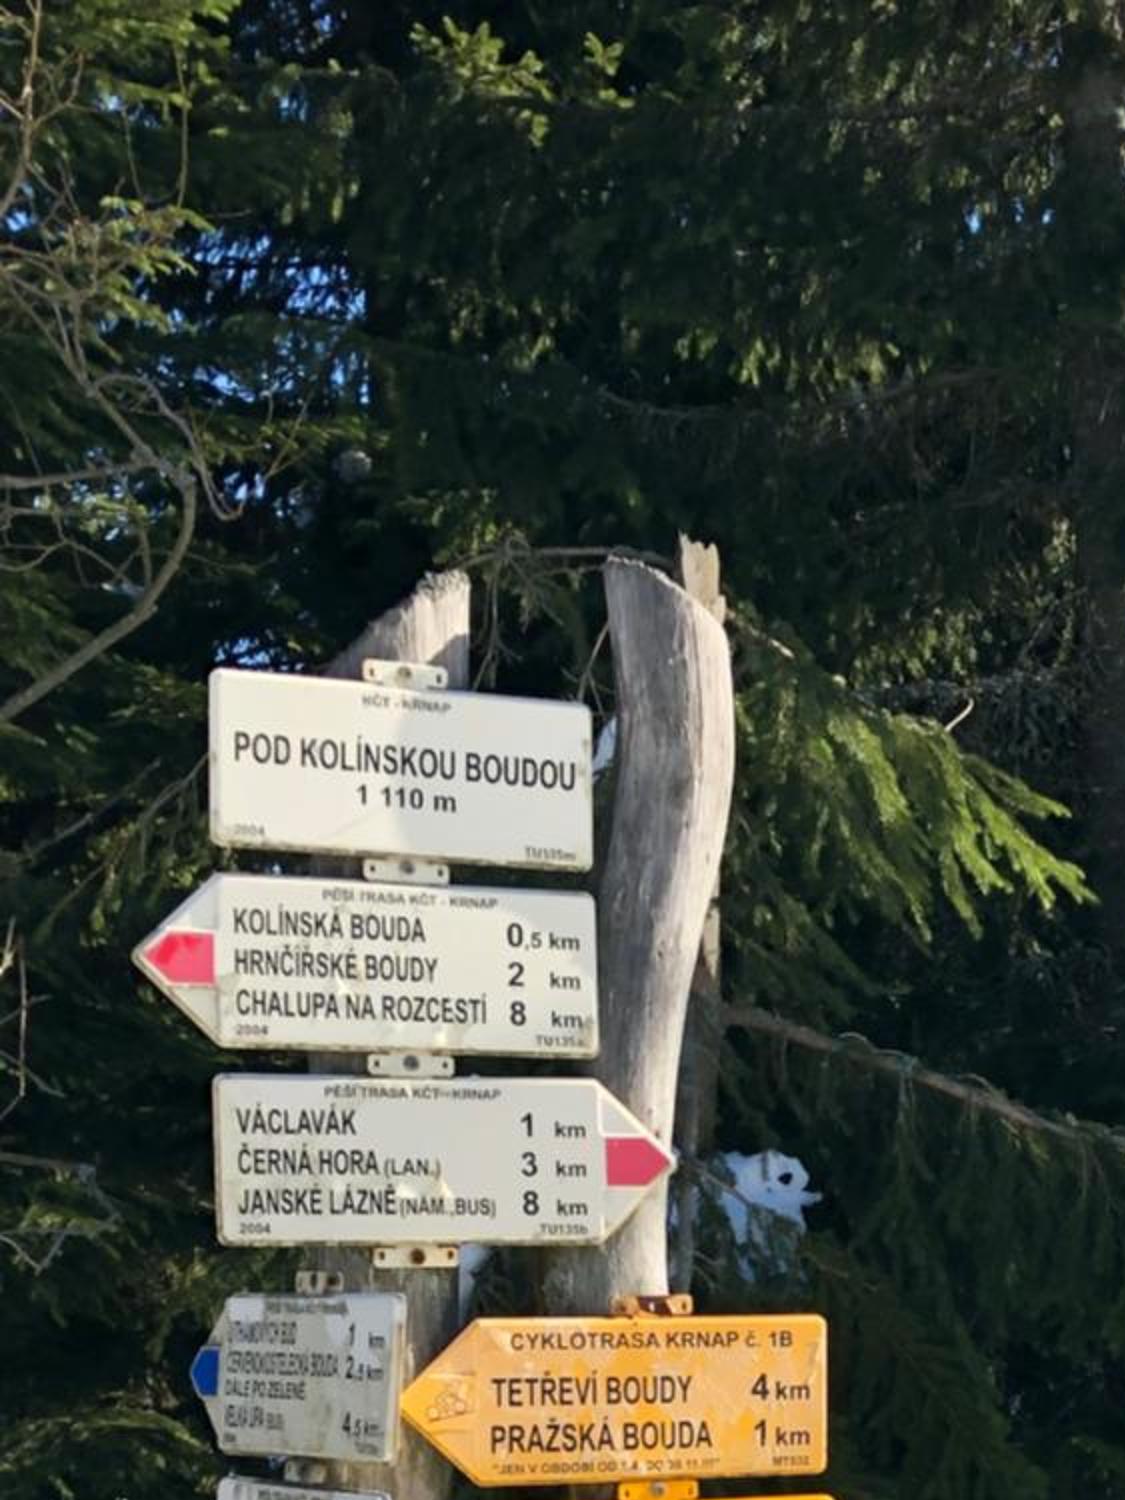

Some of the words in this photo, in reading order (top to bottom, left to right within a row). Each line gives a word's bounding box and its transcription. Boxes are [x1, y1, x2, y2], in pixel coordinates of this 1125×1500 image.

[234, 731, 290, 764] POD
[301, 735, 455, 780] KOLÍNSKOU
[465, 752, 575, 790] BOUDOU
[357, 785, 368, 806] 1
[383, 787, 424, 809] 110
[433, 794, 456, 812] m
[361, 890, 406, 905] TRASA
[450, 897, 498, 909] KRNAP
[233, 905, 344, 938] KOLÍNSKÁ
[351, 914, 426, 943] BOUDA
[507, 923, 542, 950] 0,5
[549, 932, 580, 951] km
[234, 944, 357, 979] HRNČÍŘSKÉ
[365, 955, 438, 982] BOUDY
[508, 962, 524, 987] 2
[550, 971, 581, 990] km
[237, 989, 336, 1018] CHALUPA
[346, 994, 375, 1020] NA
[382, 992, 487, 1025] ROZCESTÍ
[510, 1001, 526, 1027] 8
[551, 1010, 583, 1029] km
[236, 1023, 268, 1036] 2004
[362, 1086, 408, 1099] TRASA
[452, 1088, 501, 1100] KRNAP
[237, 1106, 356, 1135] VÁCLAVÁK
[520, 1114, 534, 1138] 1
[554, 1121, 586, 1139] km
[238, 1143, 313, 1175] ČERNÁ
[319, 1149, 379, 1175] HORA
[384, 1158, 441, 1179] (LAN.)
[521, 1152, 538, 1177] 3
[555, 1161, 587, 1179] km
[238, 1183, 322, 1216] JANSKÉ
[329, 1183, 396, 1215] LÁZNĚ
[523, 1190, 539, 1216] 8
[557, 1199, 588, 1216] km
[239, 1222, 271, 1235] 2004
[368, 1332, 386, 1349] km
[511, 1330, 660, 1351] CYKLOTRASA
[666, 1330, 740, 1349] KRNAP
[769, 1330, 793, 1349] 1B
[366, 1365, 385, 1381] km
[492, 1370, 598, 1407] TETŘEVÍ
[606, 1375, 693, 1404] BOUDY
[751, 1374, 769, 1401] 4
[775, 1380, 811, 1401] km
[490, 1416, 615, 1454] PRAŽSKÁ
[624, 1420, 712, 1450] BOUDA
[753, 1420, 767, 1447] 1
[775, 1428, 811, 1447] km
